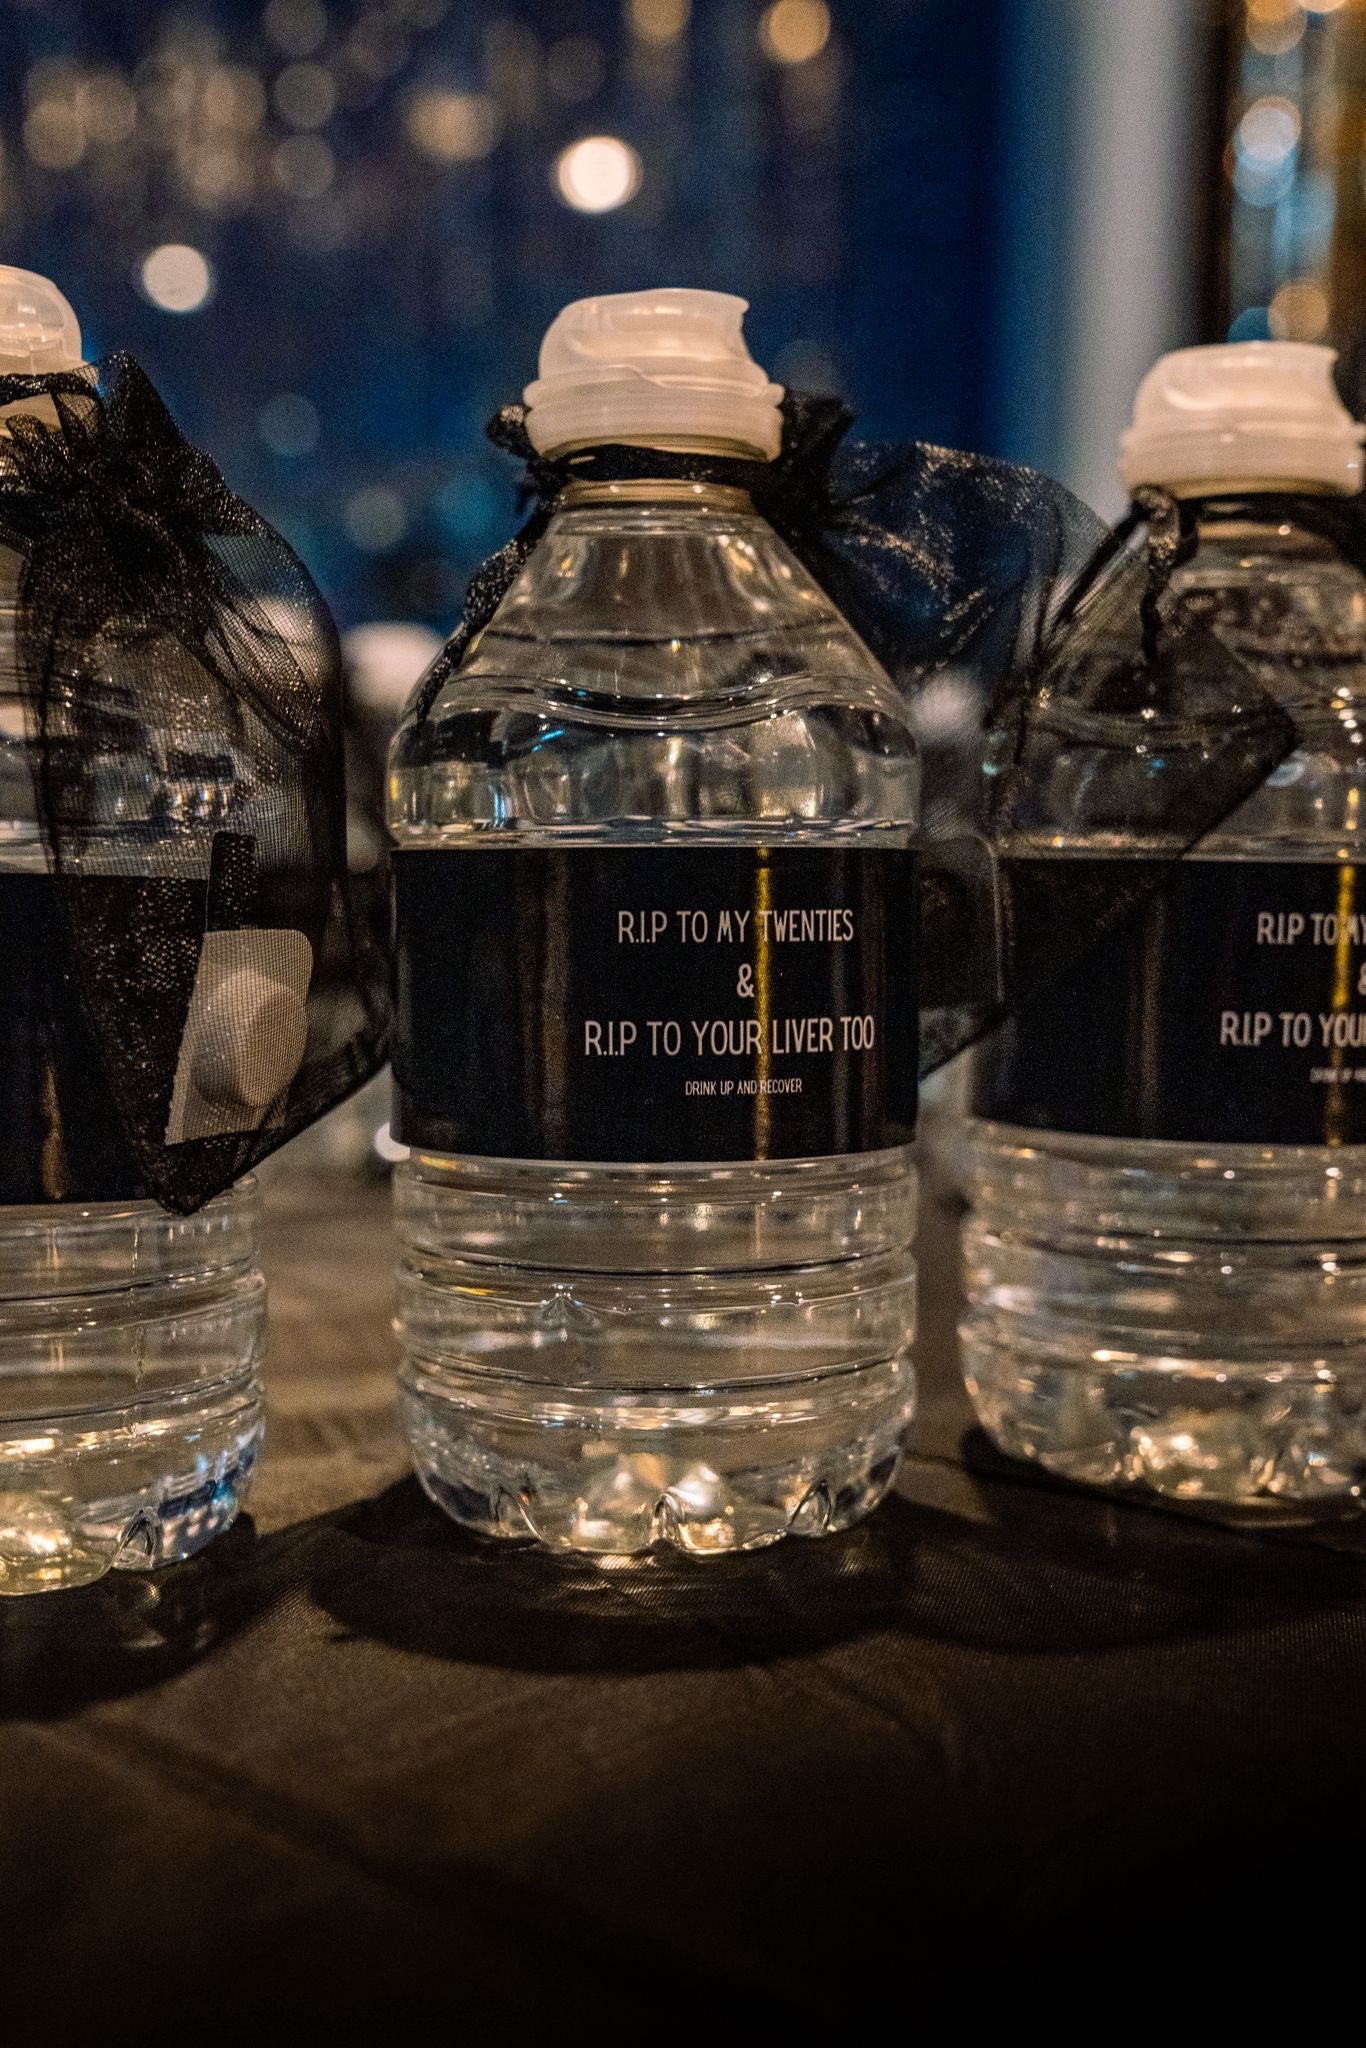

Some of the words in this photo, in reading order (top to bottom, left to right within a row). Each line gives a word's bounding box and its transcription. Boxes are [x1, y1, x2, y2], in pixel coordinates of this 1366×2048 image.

[618, 911, 668, 943] R.I.P
[676, 911, 708, 943] TO
[717, 910, 750, 943] MY
[758, 909, 854, 943] TWENTIES
[1311, 913, 1337, 945] TO
[736, 963, 755, 998] &
[585, 1020, 637, 1056] R.I.P
[646, 1021, 681, 1056] TO
[691, 1020, 763, 1056] YOUR
[772, 1017, 834, 1055] LIVER
[840, 1015, 875, 1051] TOO
[1279, 1013, 1312, 1047] TO
[685, 1080, 717, 1096] DRINK
[720, 1080, 734, 1095] UP
[737, 1079, 758, 1095] AND
[760, 1077, 803, 1094] RECOVER
